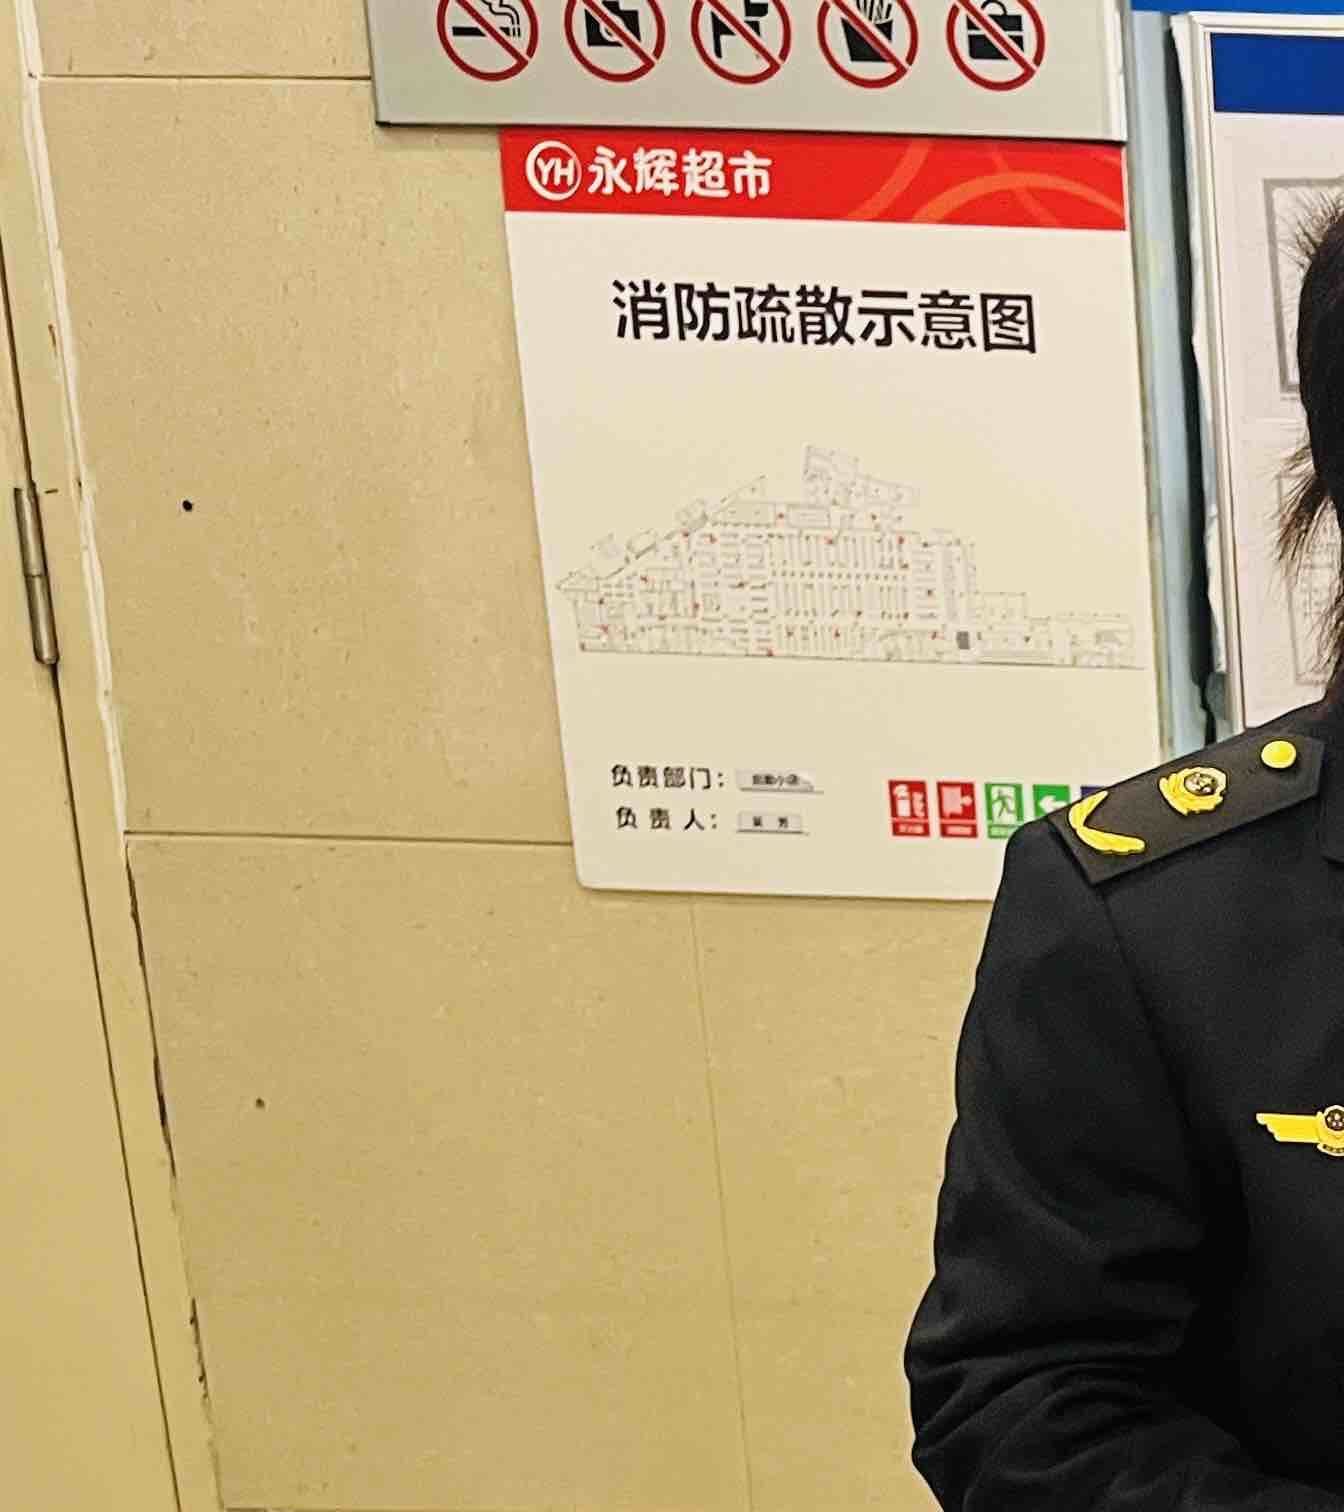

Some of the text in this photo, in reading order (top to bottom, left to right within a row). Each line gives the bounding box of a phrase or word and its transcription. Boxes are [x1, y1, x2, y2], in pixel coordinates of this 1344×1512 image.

[588, 146, 772, 198] 永辉超市
[611, 278, 1038, 355] 消防疏散示意图
